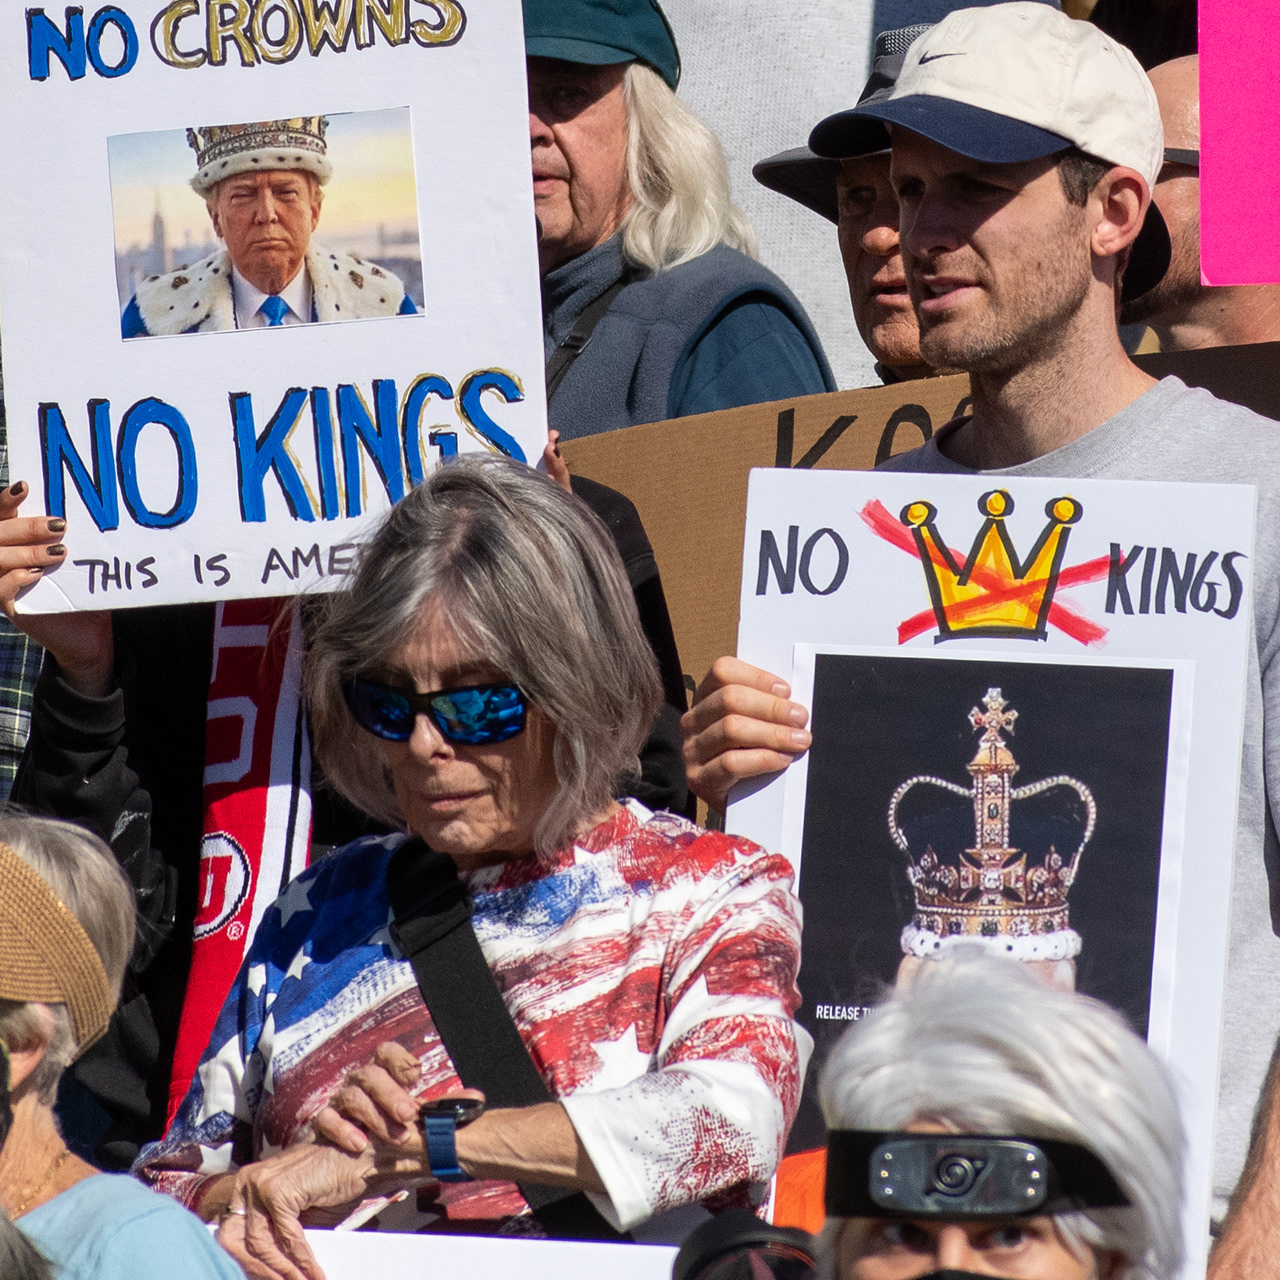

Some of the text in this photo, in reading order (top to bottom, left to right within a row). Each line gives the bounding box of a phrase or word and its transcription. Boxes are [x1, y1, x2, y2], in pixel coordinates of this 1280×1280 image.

[24, 4, 140, 81] NO
[37, 367, 528, 533] NO KINGS
[73, 542, 371, 594] THIS IS AME
[755, 524, 1248, 620] NO KINGS
[816, 1004, 861, 1021] RELEASE
